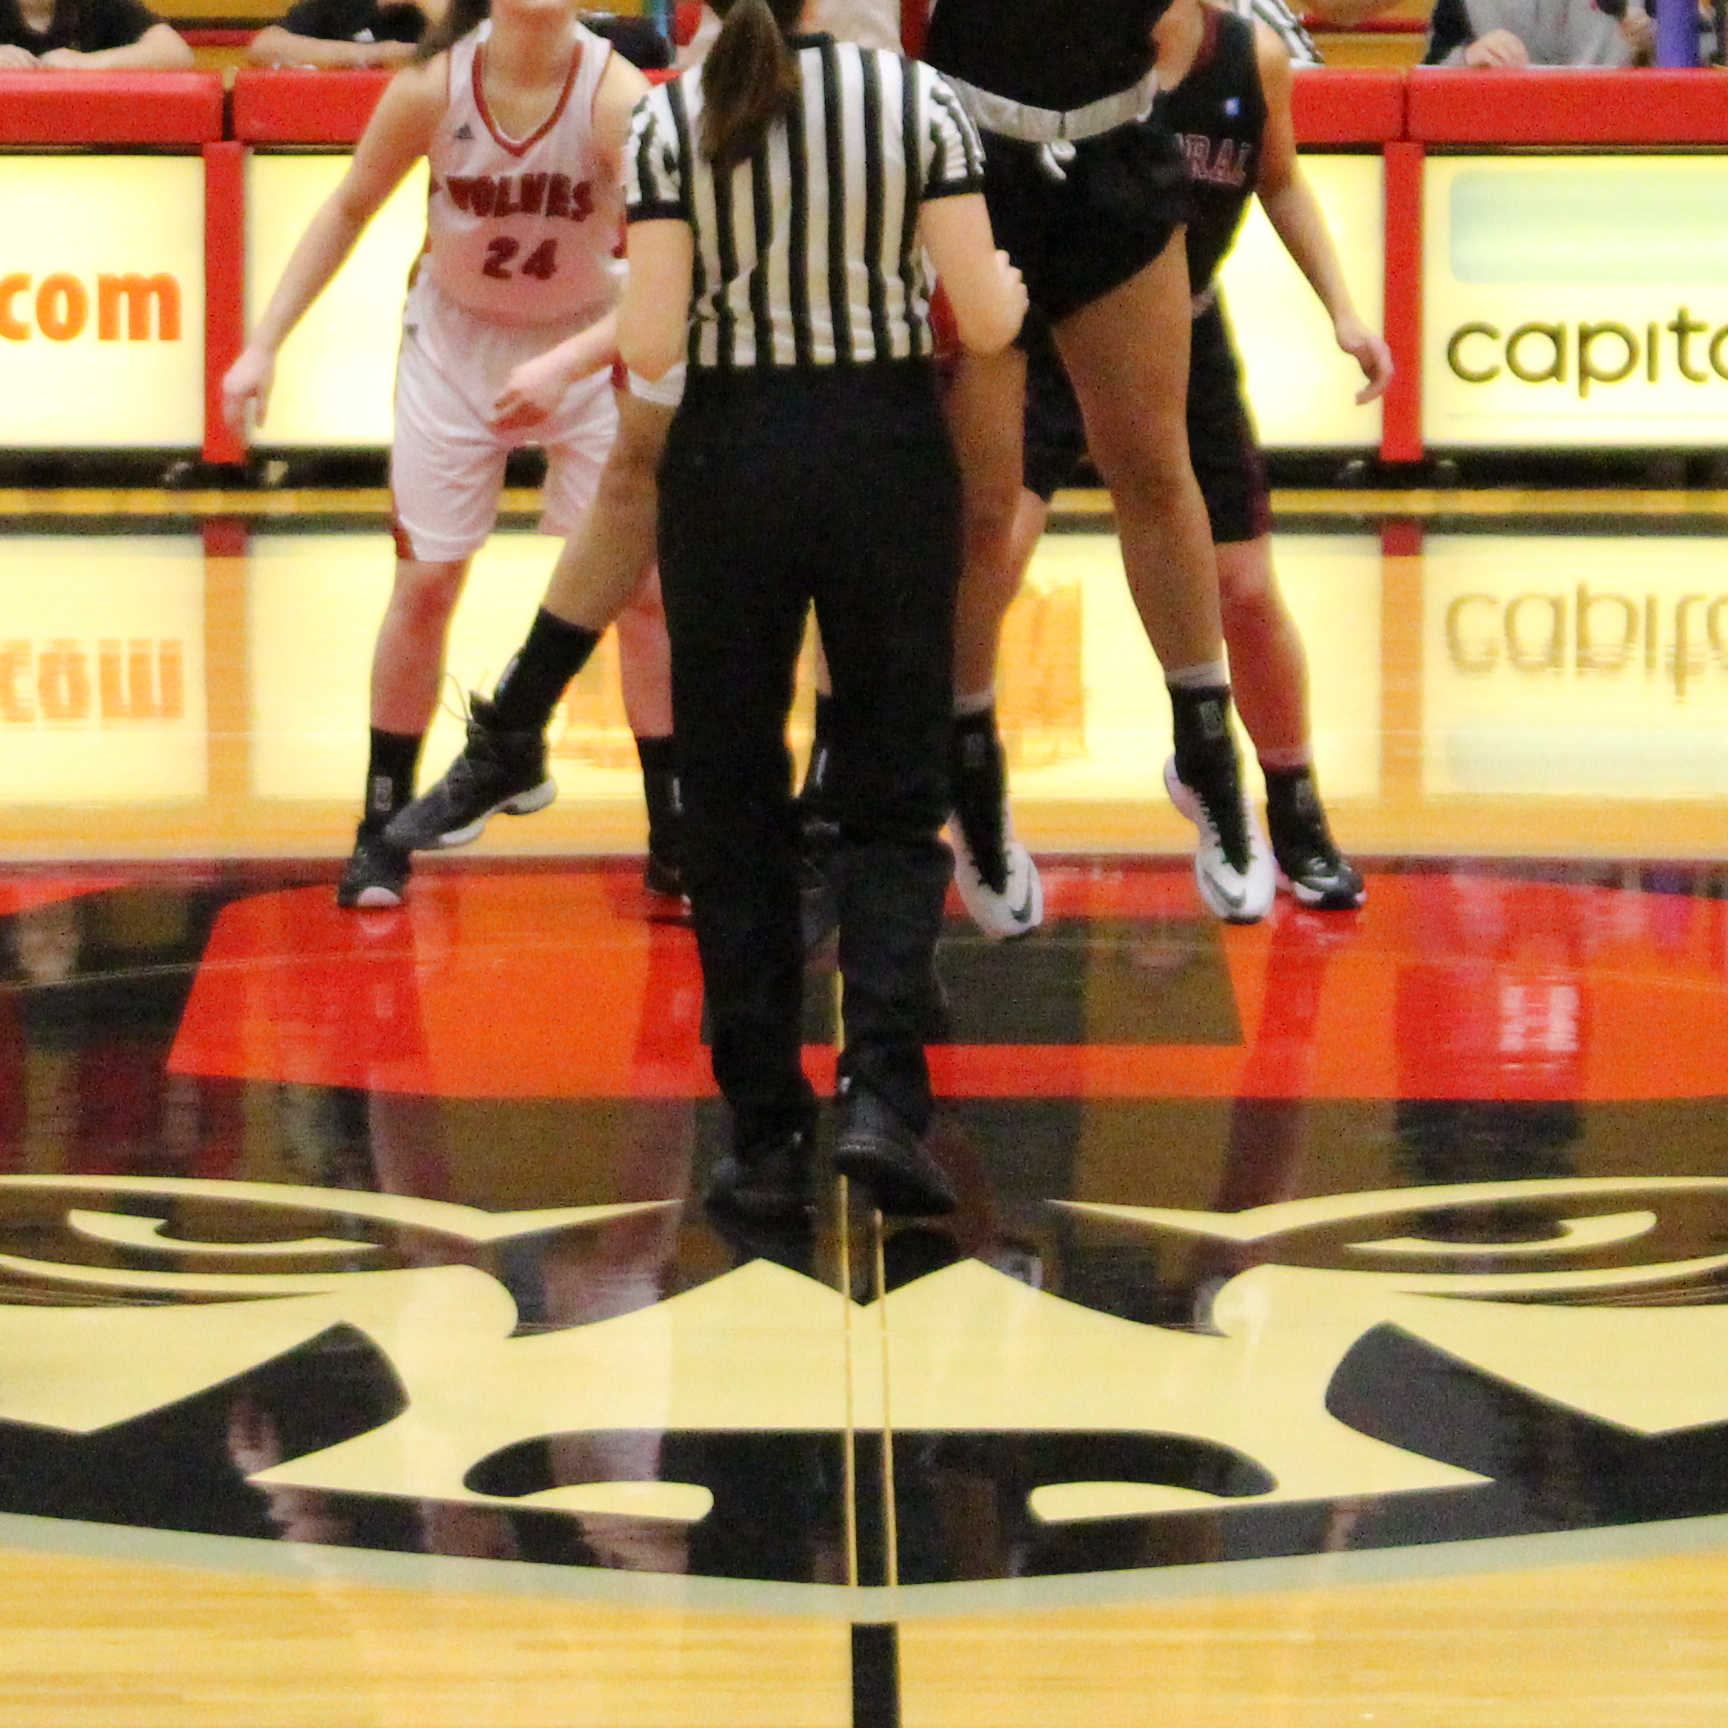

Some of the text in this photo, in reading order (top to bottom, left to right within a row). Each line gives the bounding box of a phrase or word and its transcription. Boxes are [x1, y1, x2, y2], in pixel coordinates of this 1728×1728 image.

[1175, 133, 1252, 188] RAL
[446, 172, 595, 222] WOLVES
[482, 235, 558, 281] 24
